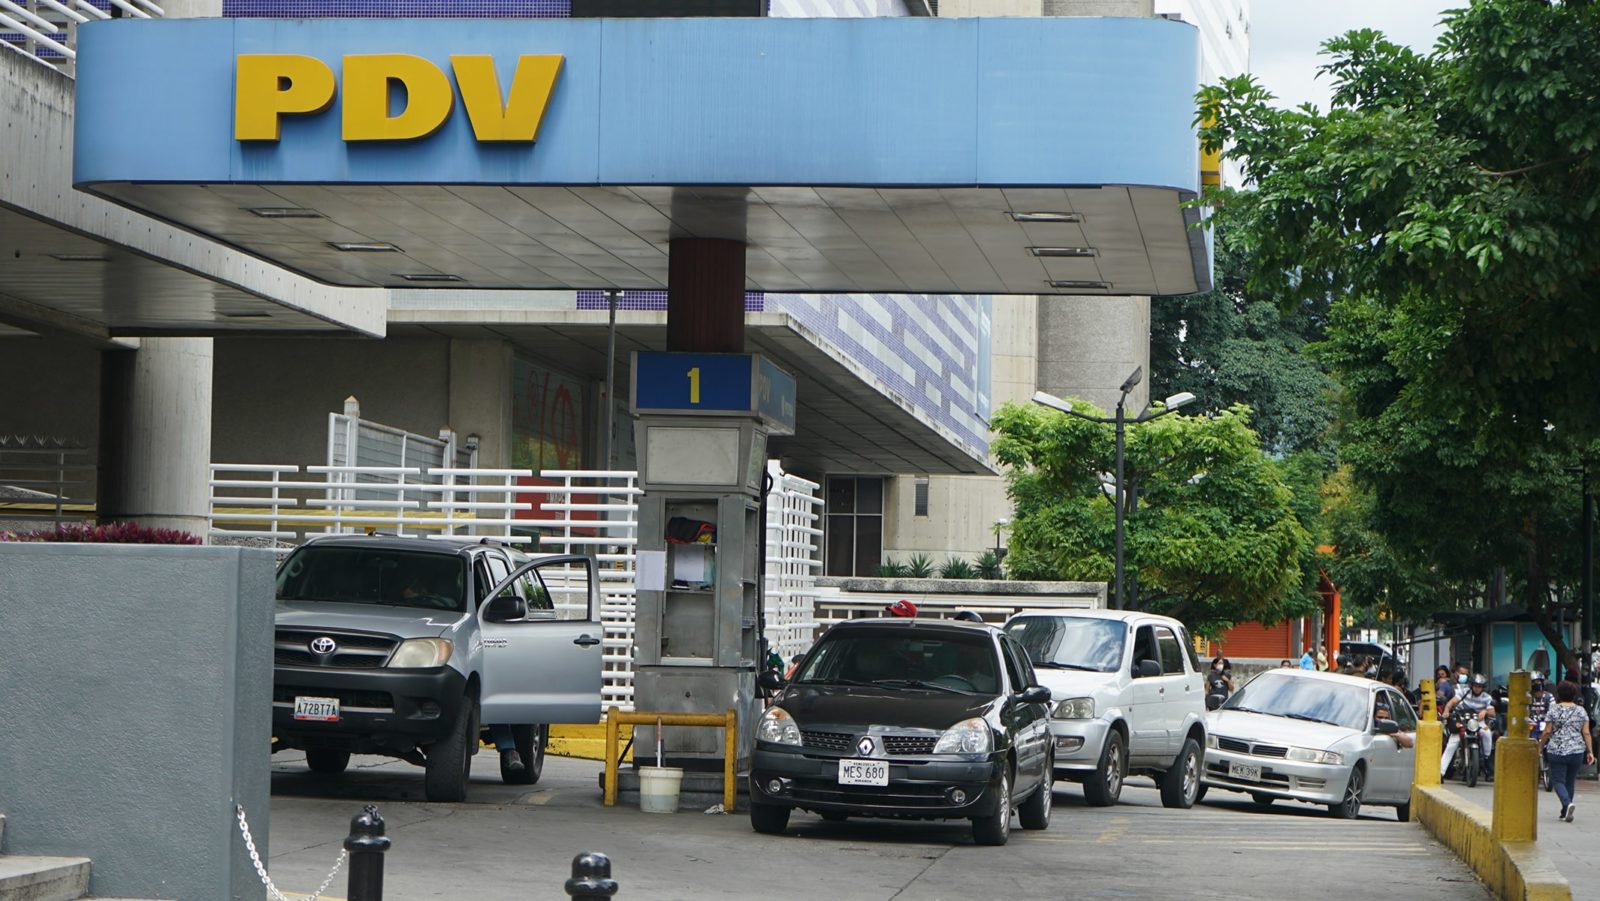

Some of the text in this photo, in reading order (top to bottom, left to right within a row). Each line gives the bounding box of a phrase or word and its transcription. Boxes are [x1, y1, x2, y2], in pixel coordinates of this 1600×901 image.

[234, 53, 566, 143] PDV
[687, 367, 701, 404] 1
[297, 701, 336, 716] A72BT7A
[843, 766, 885, 779] MES 680
